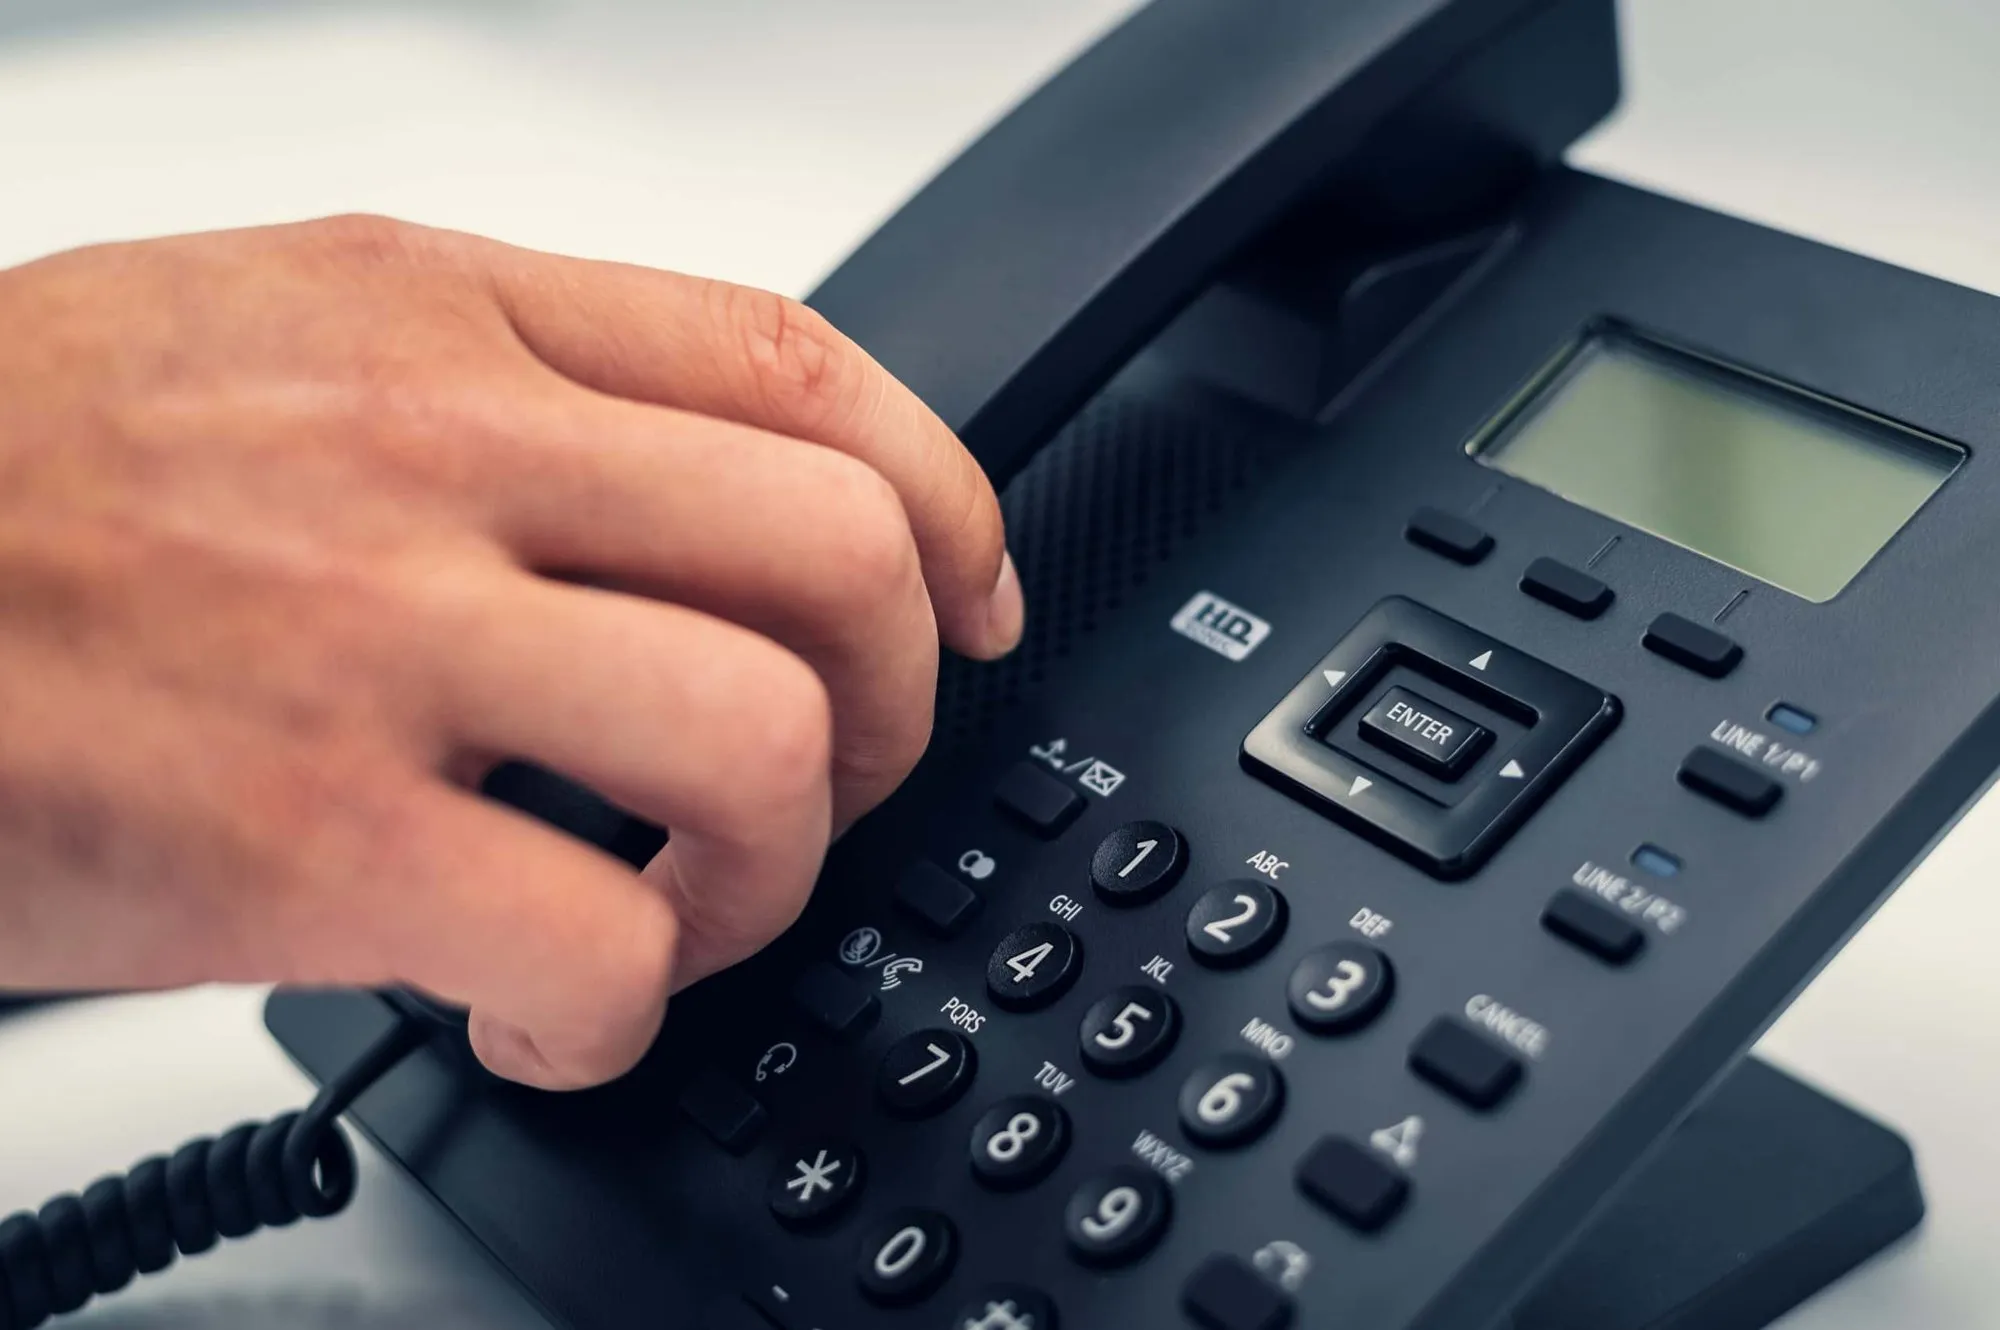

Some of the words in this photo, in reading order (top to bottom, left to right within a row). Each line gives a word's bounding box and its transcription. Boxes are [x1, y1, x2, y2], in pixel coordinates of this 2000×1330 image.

[1386, 702, 1453, 745] ENTER
[1711, 720, 1765, 757] LINE
[1118, 839, 1158, 878] 1
[1246, 850, 1290, 879] ABC
[1573, 861, 1628, 901] LINE
[1049, 895, 1082, 921] GHI
[1204, 895, 1258, 943] 2
[1349, 907, 1393, 938] DEF
[1006, 942, 1054, 983] 4
[1140, 955, 1175, 984] JKL
[1306, 960, 1366, 1010] 3
[940, 996, 985, 1034] PQRS
[1095, 1002, 1152, 1049] 5
[1464, 994, 1549, 1059] CANCEL
[1240, 1017, 1294, 1060] MNO
[898, 1043, 950, 1085] 7
[1033, 1060, 1075, 1095] TUV
[1197, 1072, 1256, 1124] 6
[986, 1112, 1041, 1162] 8
[1131, 1128, 1194, 1183] WXYZ
[1080, 1186, 1142, 1241] 9
[874, 1226, 927, 1278] 0
